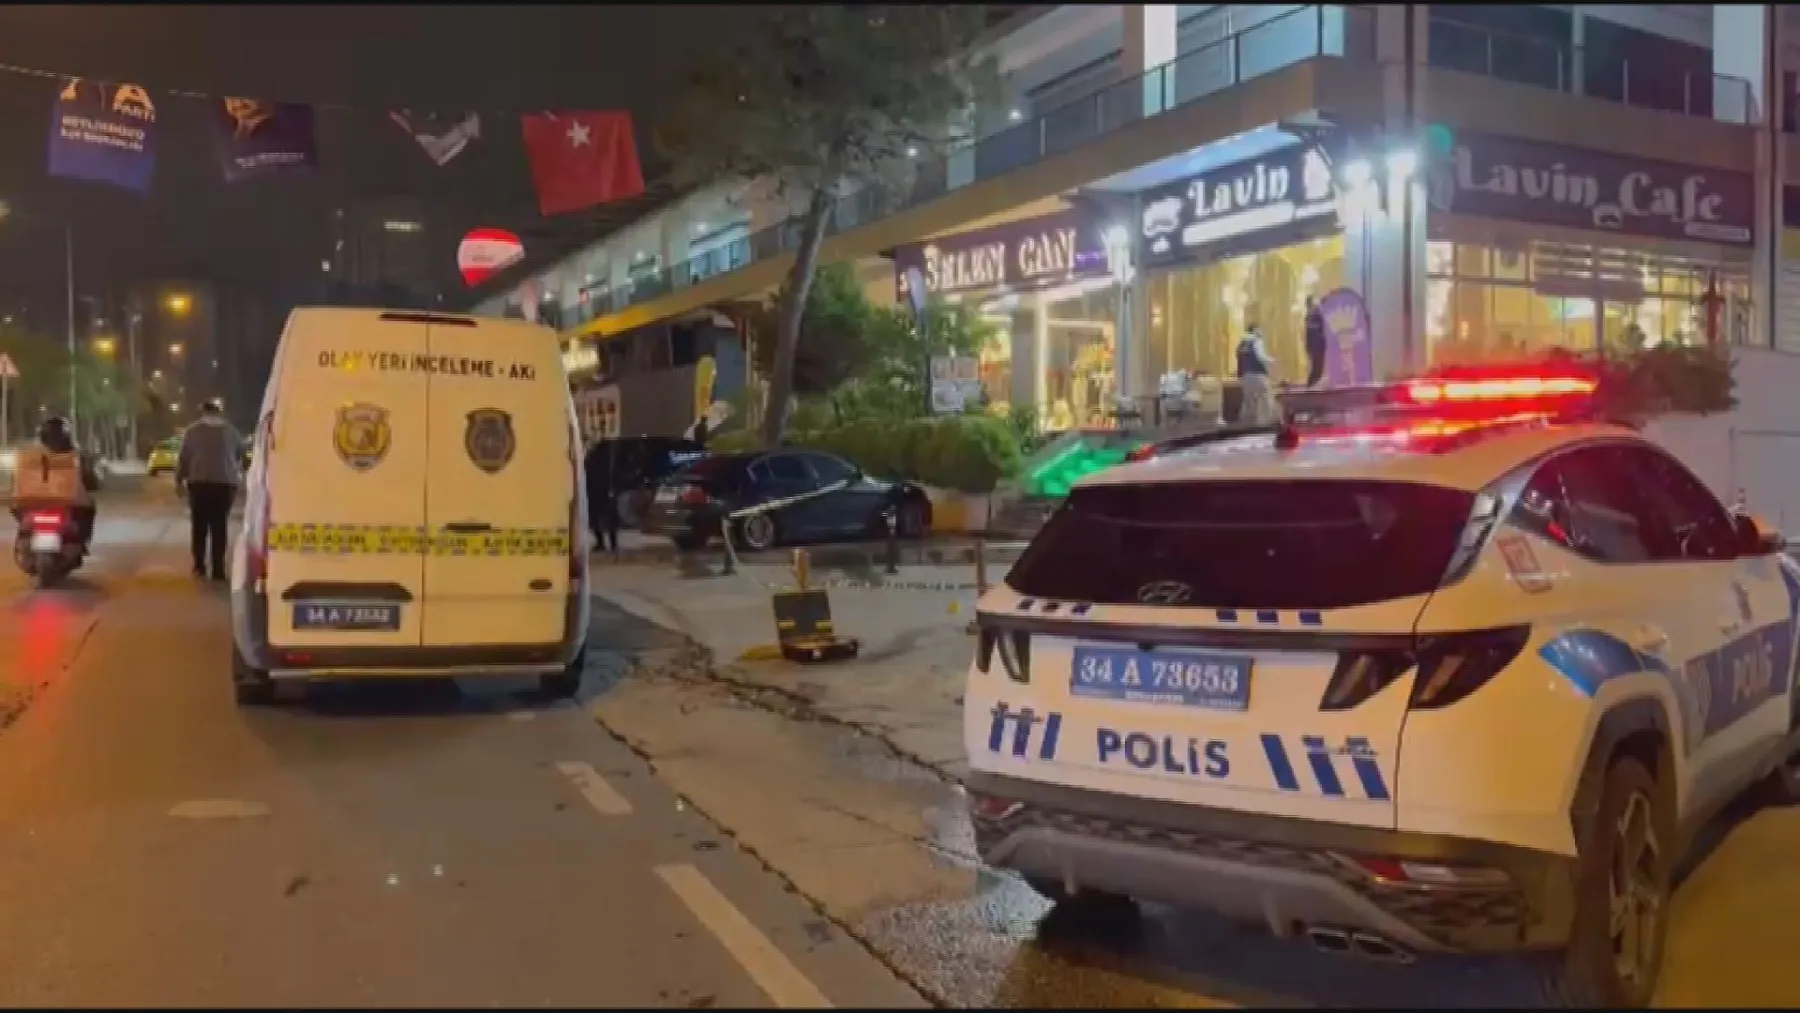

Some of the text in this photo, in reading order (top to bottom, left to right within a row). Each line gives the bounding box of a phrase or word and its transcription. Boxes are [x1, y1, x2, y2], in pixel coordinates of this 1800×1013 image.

[1186, 162, 1291, 216] Lavin
[1456, 146, 1724, 223] Lavin Cafe
[1018, 228, 1076, 280] CAN
[1080, 656, 1238, 693] 34 A 73653
